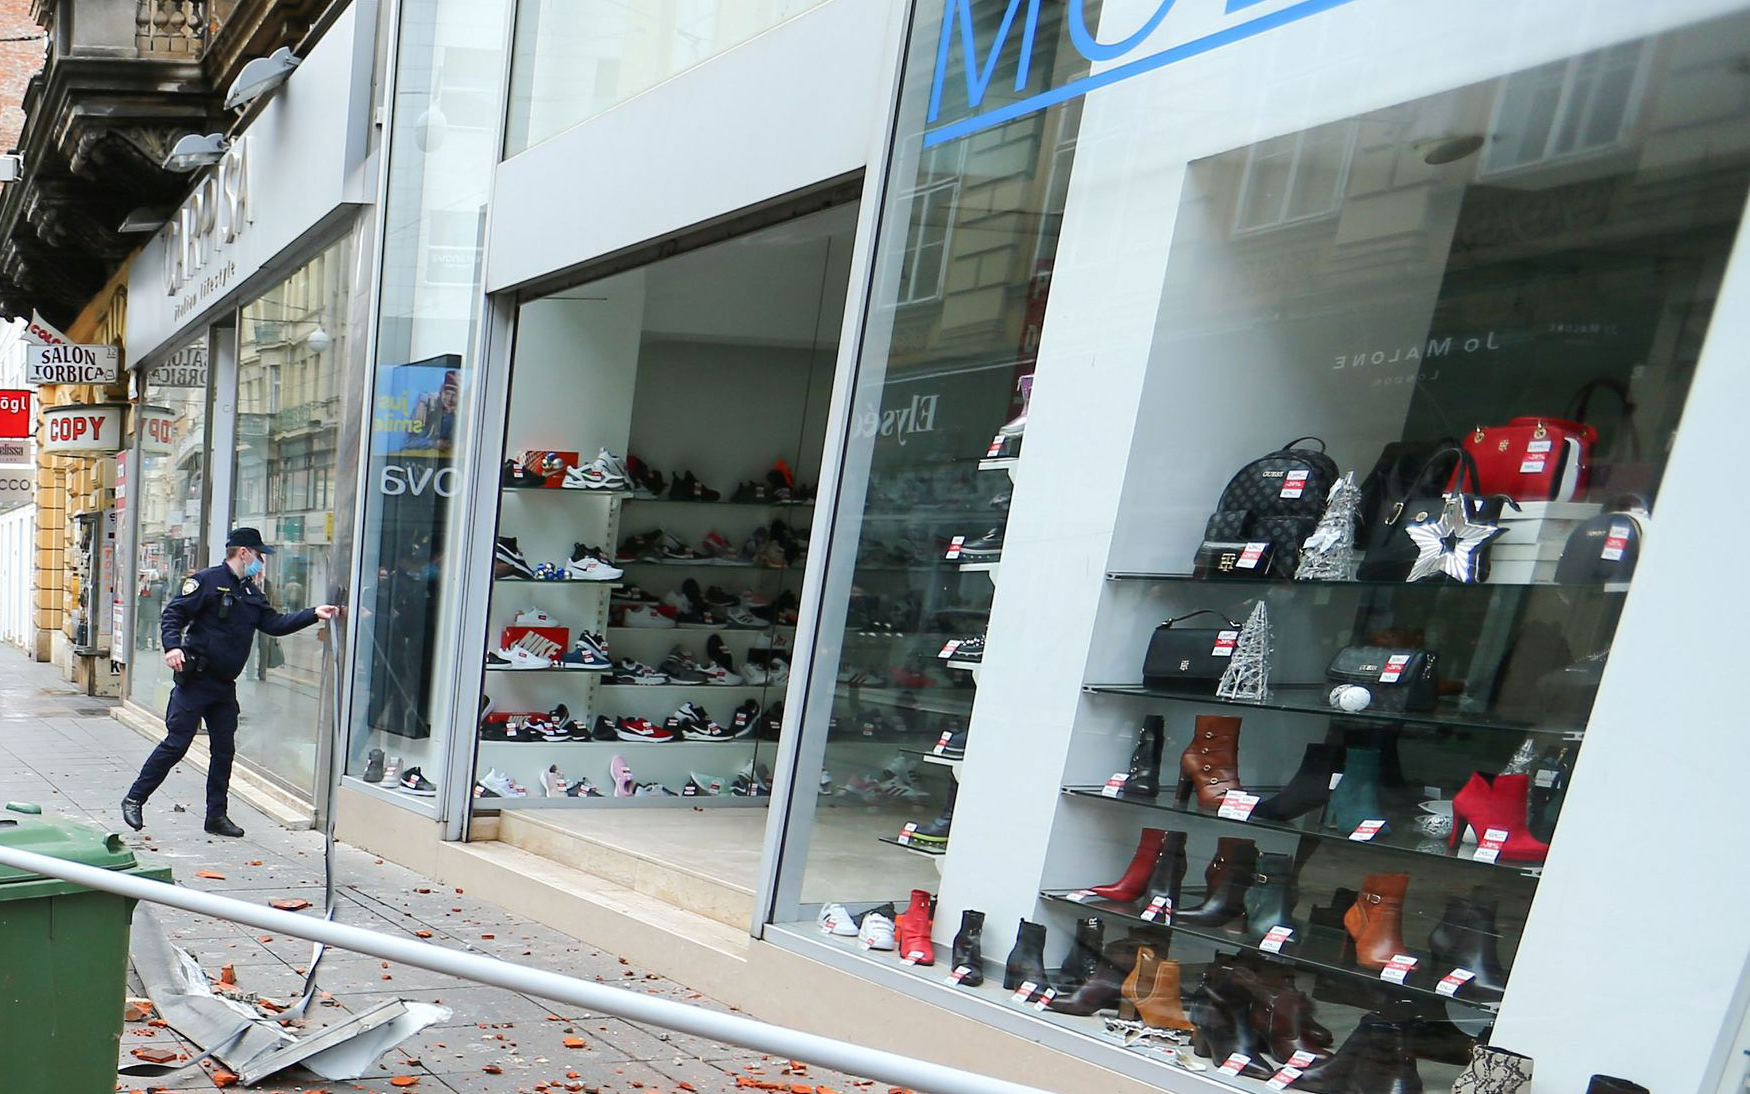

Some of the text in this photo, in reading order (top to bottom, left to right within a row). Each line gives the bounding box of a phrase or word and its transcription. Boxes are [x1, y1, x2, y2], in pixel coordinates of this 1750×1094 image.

[41, 345, 96, 366] SALON
[35, 365, 105, 383] TORBICA
[49, 416, 106, 442] COPY
[521, 629, 563, 660] NIKE
